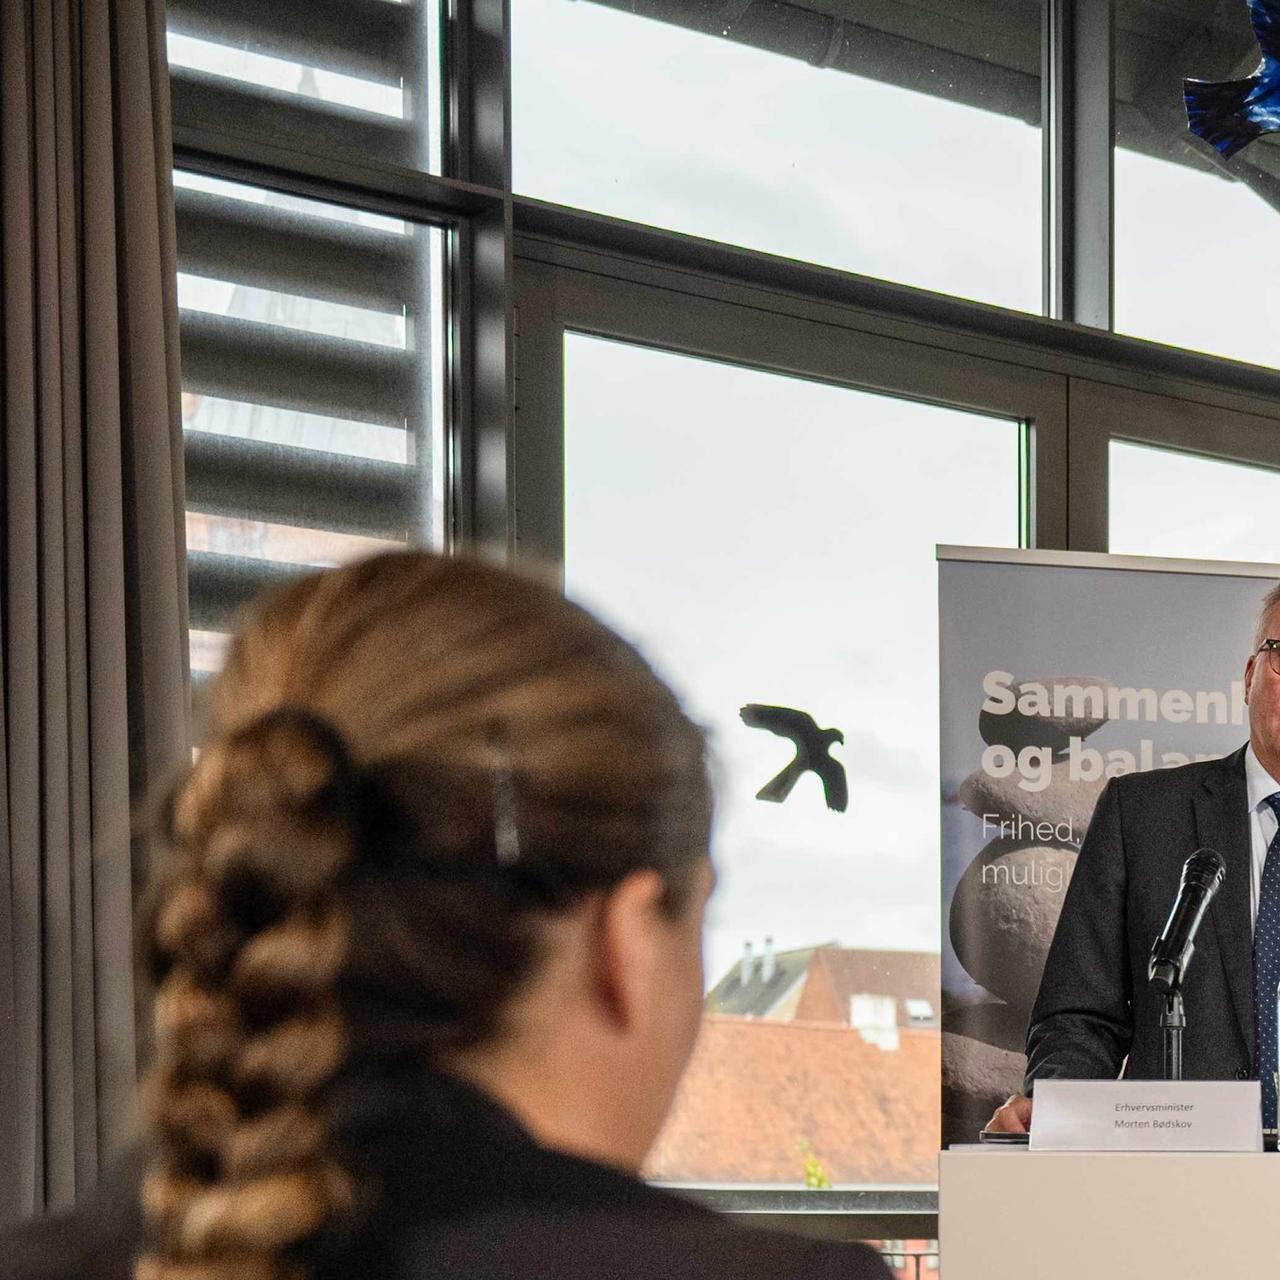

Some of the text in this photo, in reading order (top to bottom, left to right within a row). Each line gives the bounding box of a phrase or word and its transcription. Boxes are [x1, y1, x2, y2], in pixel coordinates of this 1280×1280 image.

[982, 744, 1052, 793] og
[983, 813, 1080, 845] Frihed,
[1115, 1103, 1194, 1112] Erhvervsminister
[1115, 1120, 1192, 1129] Morten Bødskov
